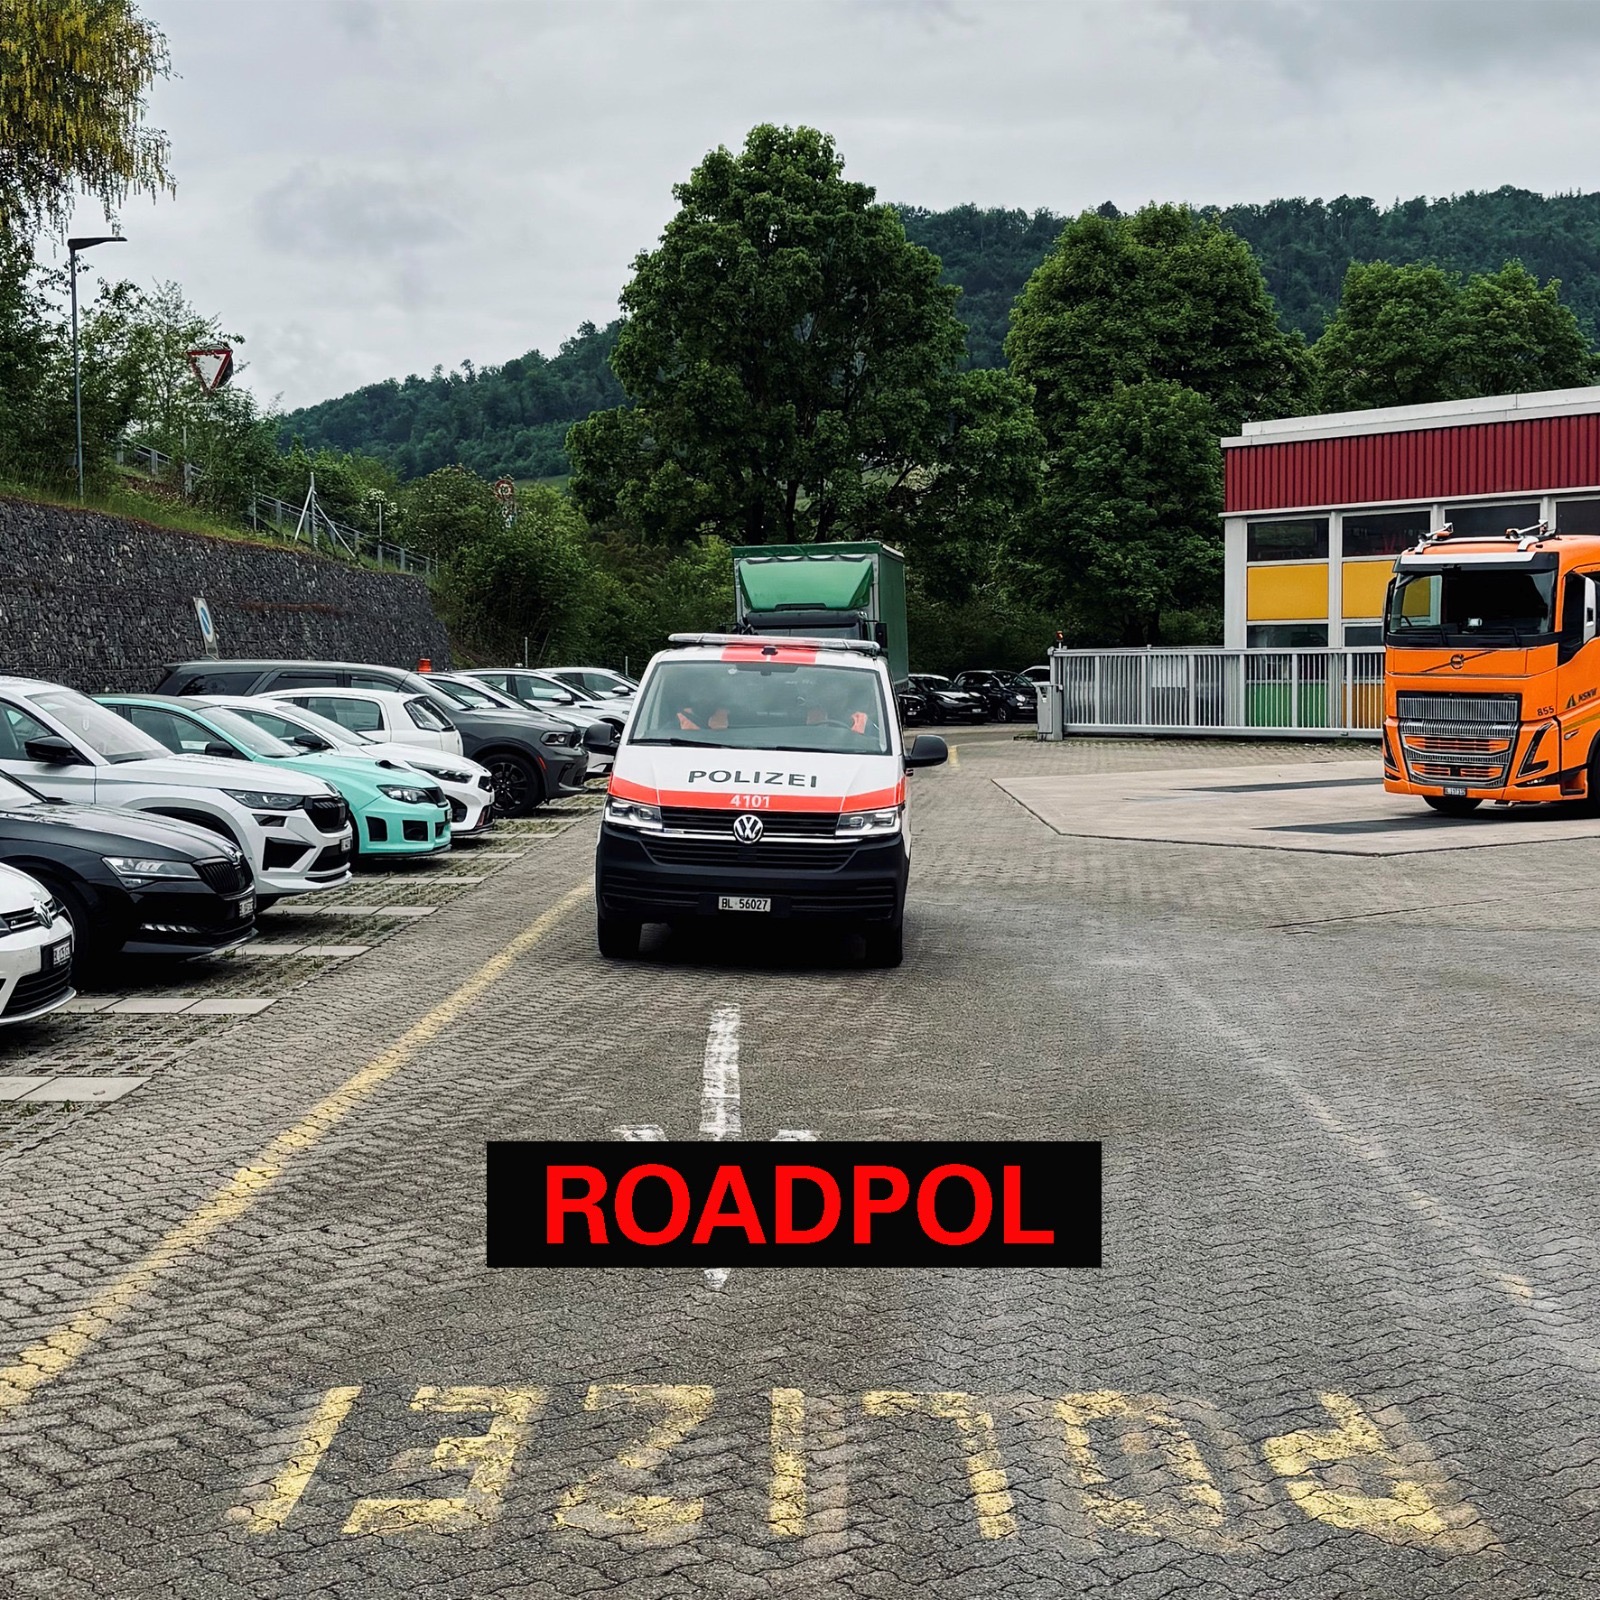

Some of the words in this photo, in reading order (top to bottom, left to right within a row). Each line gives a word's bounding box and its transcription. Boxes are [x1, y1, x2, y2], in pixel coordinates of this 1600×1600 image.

[1537, 706, 1555, 716] 855
[688, 770, 817, 788] POLIZEI
[730, 794, 771, 808] 4101
[721, 898, 733, 909] BL
[739, 898, 768, 910] 56027
